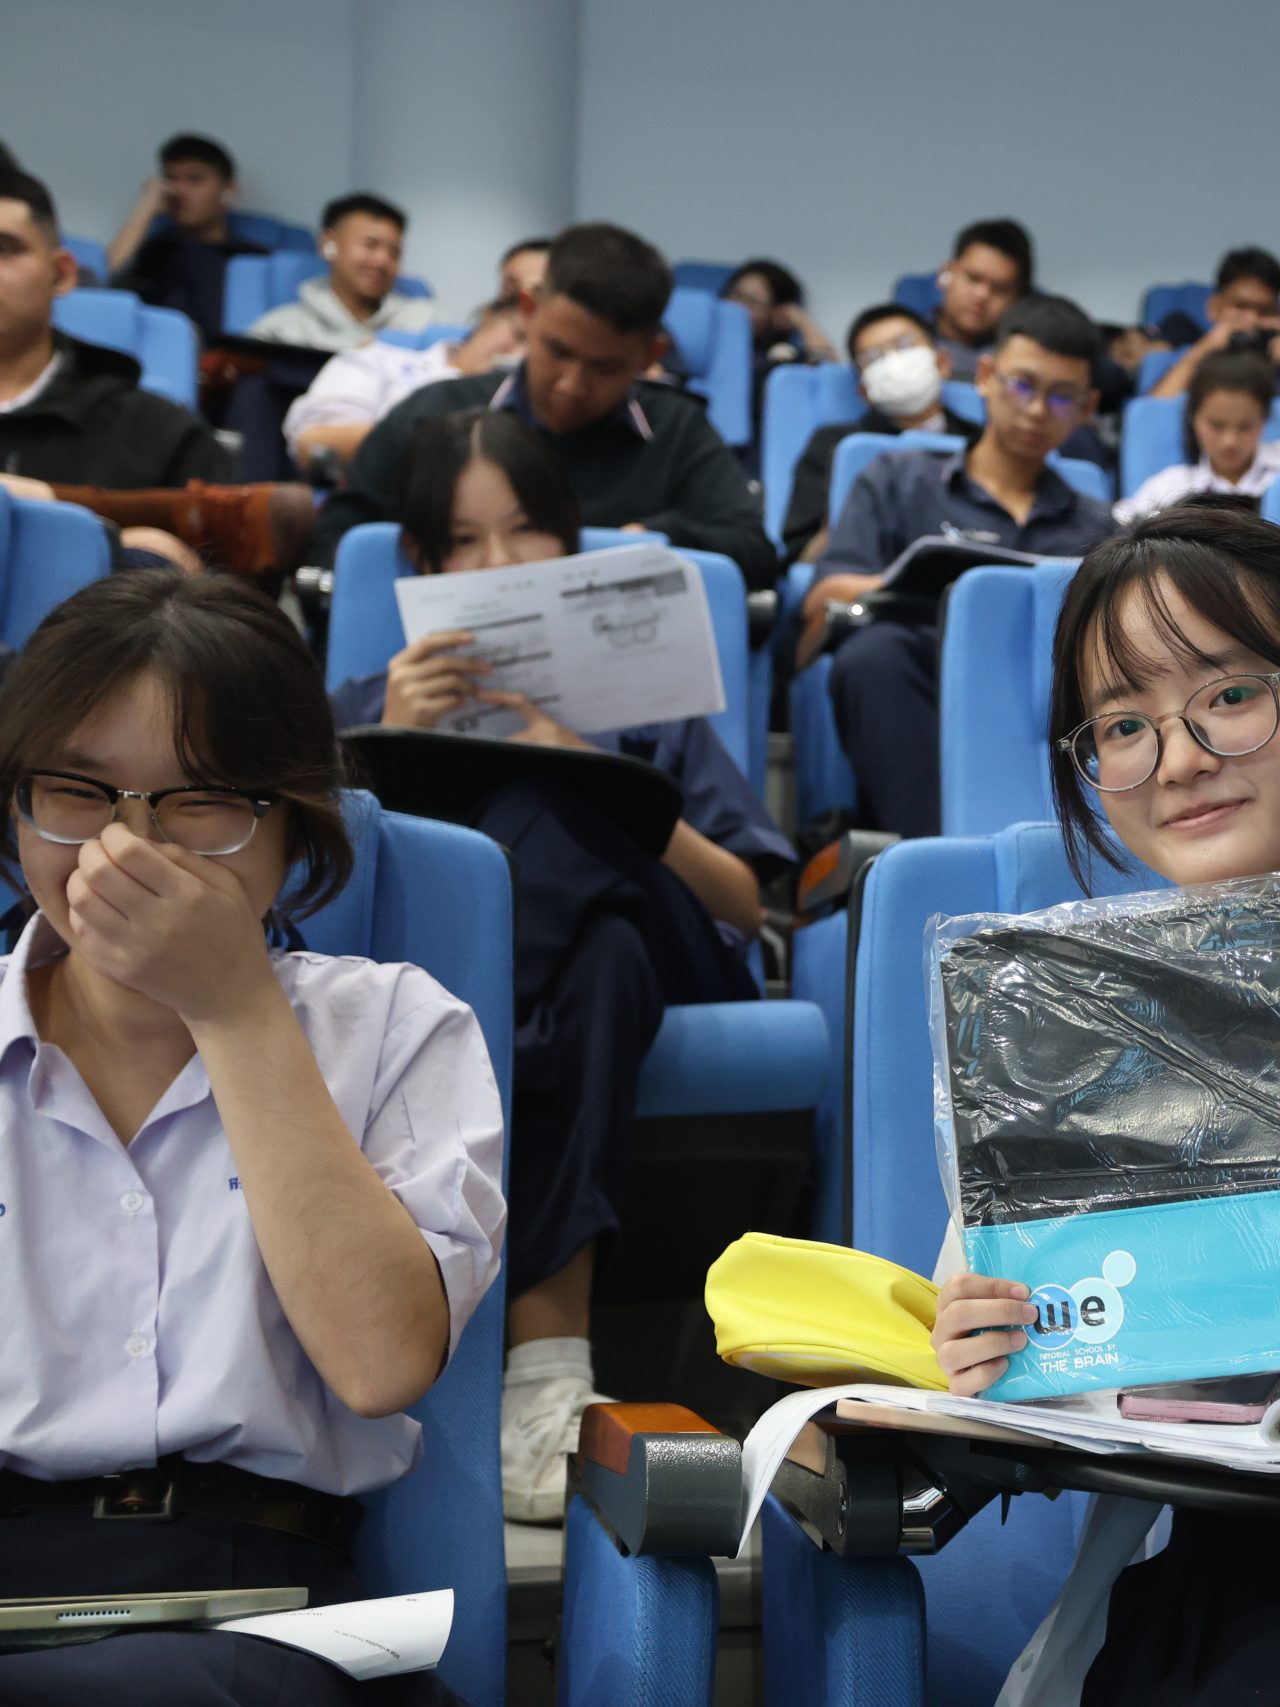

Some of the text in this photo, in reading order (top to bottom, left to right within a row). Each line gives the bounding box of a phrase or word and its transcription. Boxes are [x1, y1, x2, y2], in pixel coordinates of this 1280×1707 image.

[1033, 1296, 1105, 1334] we
[1040, 1350, 1070, 1360] TUTORIAL
[1075, 1346, 1104, 1355] SCHOOL
[1040, 1352, 1119, 1374] THE BRAIN
